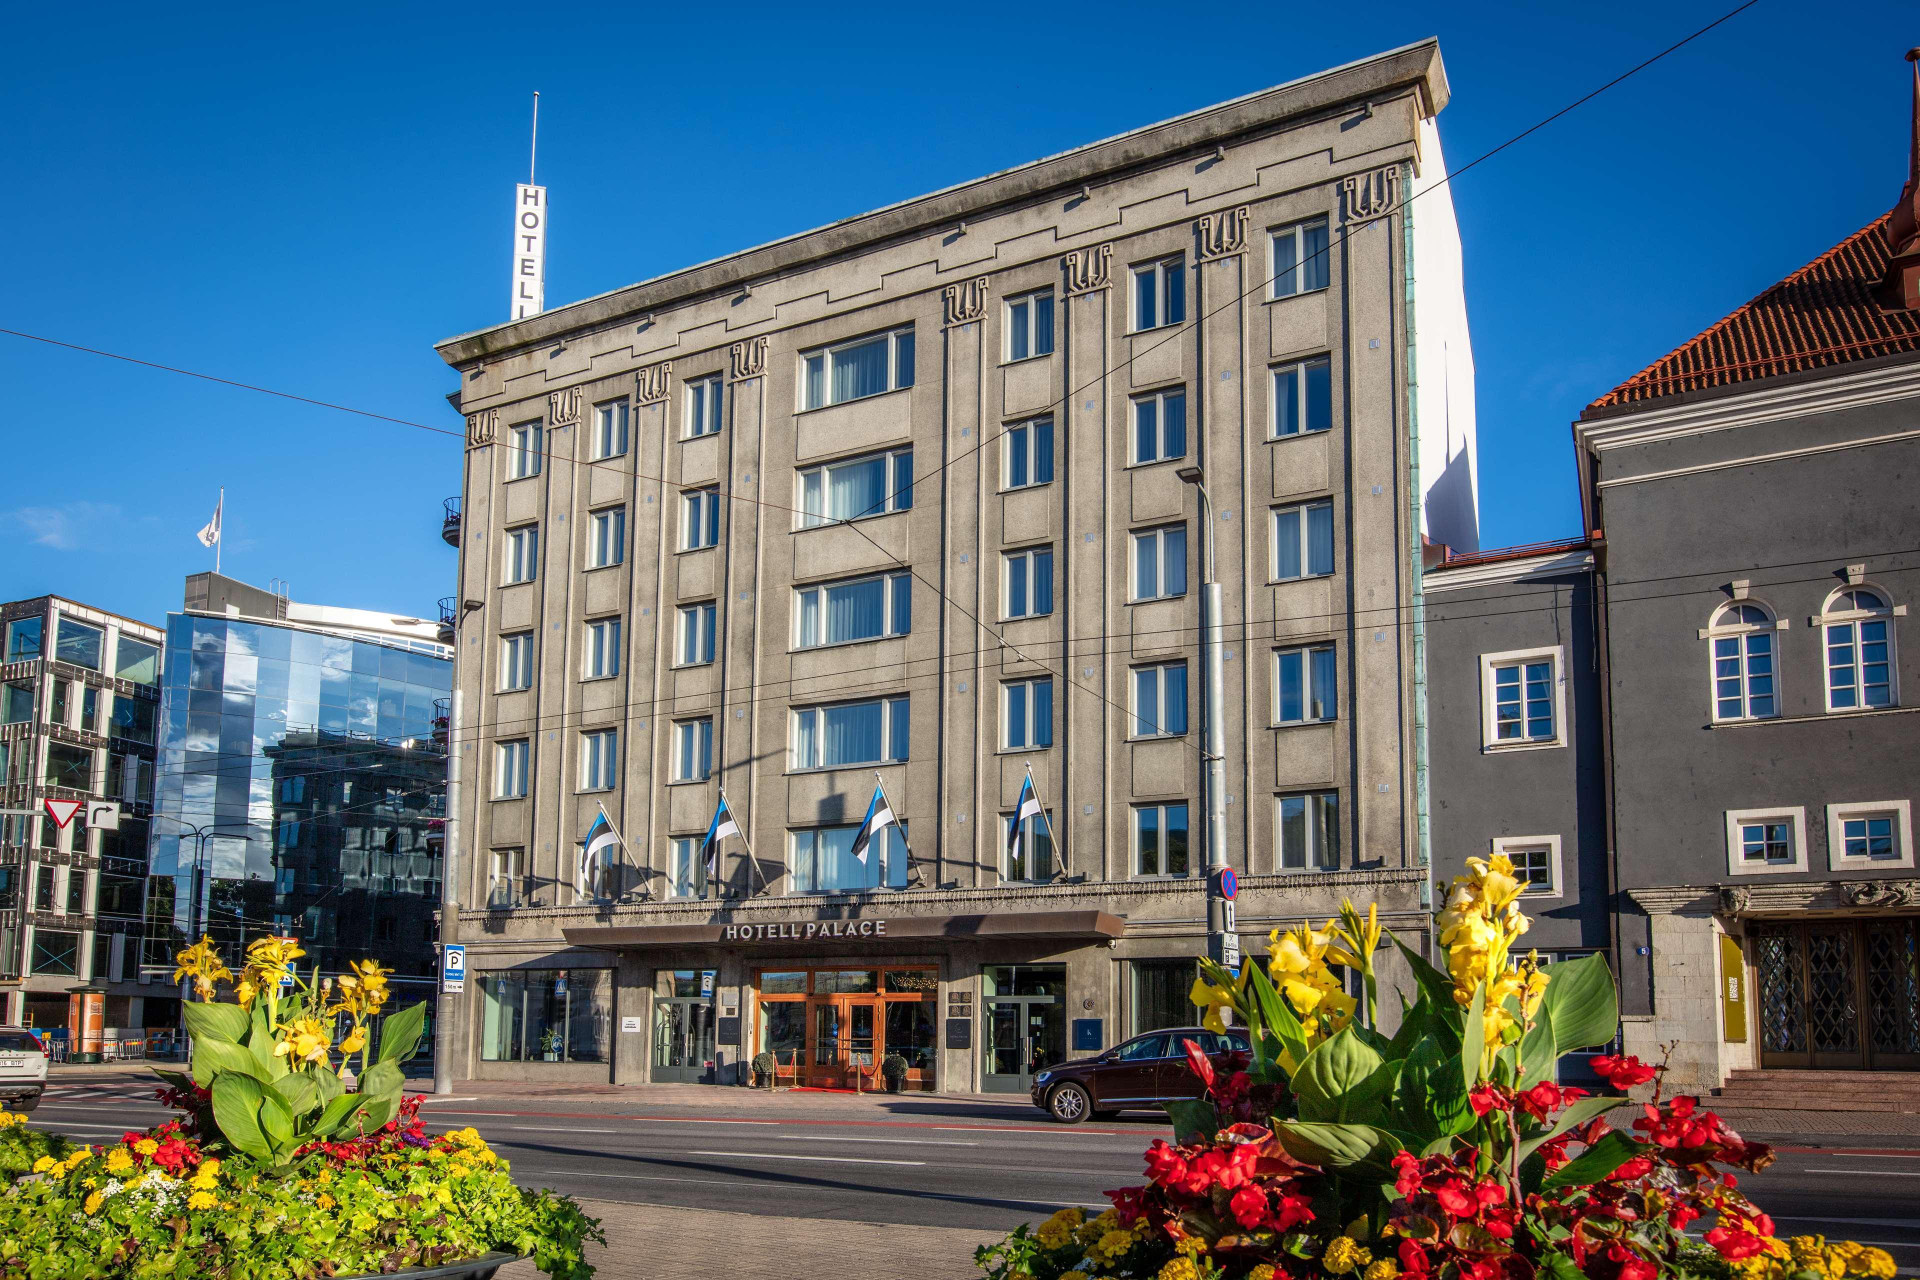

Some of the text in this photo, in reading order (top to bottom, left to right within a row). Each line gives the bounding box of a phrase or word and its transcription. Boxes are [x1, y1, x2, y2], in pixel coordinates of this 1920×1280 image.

[726, 920, 887, 940] HOTELL PALACE
[1641, 947, 1646, 955] 5
[451, 956, 459, 968] P
